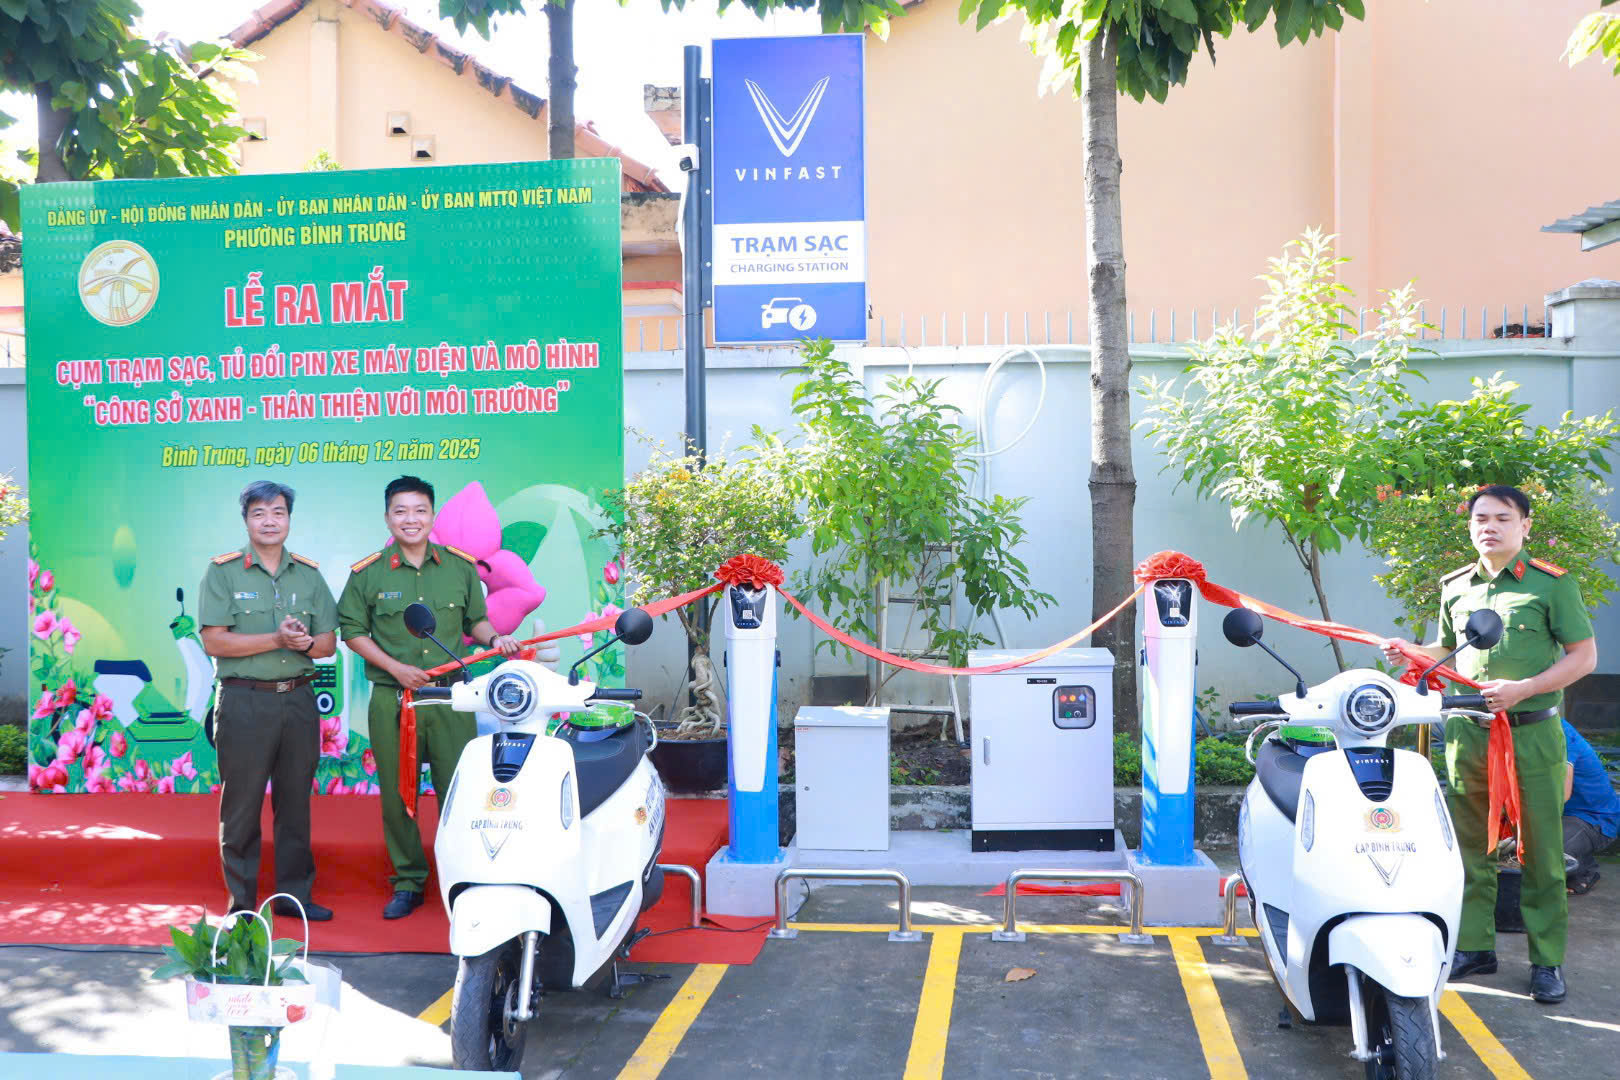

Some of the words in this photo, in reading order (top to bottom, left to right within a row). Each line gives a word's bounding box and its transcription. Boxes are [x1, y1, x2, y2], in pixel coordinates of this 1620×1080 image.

[735, 165, 842, 182] VINFAST
[48, 205, 86, 226] ĐẢNG
[90, 204, 108, 224] ỦY
[121, 204, 144, 227] HỘI
[148, 202, 186, 222] ĐỒNG
[191, 201, 230, 221] NHÂN
[234, 200, 263, 219] DÂN
[277, 195, 295, 217] ỦY
[299, 198, 328, 215] BAN
[333, 193, 373, 213] NHÂN
[377, 192, 407, 212] DÂN
[421, 188, 440, 210] ỦY
[444, 191, 474, 209] BAN
[479, 190, 518, 208] MTTQ
[522, 186, 552, 208] VIỆT
[557, 187, 592, 205] NAM
[225, 224, 295, 249] PHƯỜNG
[300, 221, 342, 245] BÌNH
[348, 221, 406, 243] TRƯNG
[730, 235, 797, 257] TRẠM
[804, 235, 849, 256] SẠC
[730, 262, 795, 273] CHARGING
[797, 262, 849, 272] STATION
[225, 271, 264, 327] LỄ
[275, 283, 322, 325] RA
[331, 265, 408, 324] MẮT
[56, 360, 102, 389] CỤM
[107, 357, 163, 387] TRẠM
[169, 356, 216, 386] SẠC,
[220, 346, 245, 380] TỦ
[250, 344, 285, 378] ĐỔI
[291, 351, 327, 377] PIN
[331, 350, 359, 375] XE
[364, 344, 411, 374] MÁY
[416, 341, 467, 377] ĐIỆN
[471, 340, 500, 371] VÀ
[505, 339, 540, 370] MÔ
[545, 338, 599, 369] HÌNH
[155, 391, 183, 425] SỞ
[187, 396, 242, 422] XANH
[260, 390, 315, 420] THÂN
[320, 388, 381, 422] THIỆN
[385, 386, 420, 416] VỚI
[426, 385, 467, 415] MÔI
[161, 445, 198, 467] Bình
[203, 445, 249, 467] Trưng,
[254, 442, 295, 467] ngày
[298, 442, 319, 463] 06
[322, 440, 369, 465] tháng
[374, 440, 394, 461] 12
[397, 438, 434, 461] năm
[437, 438, 481, 460] 2025
